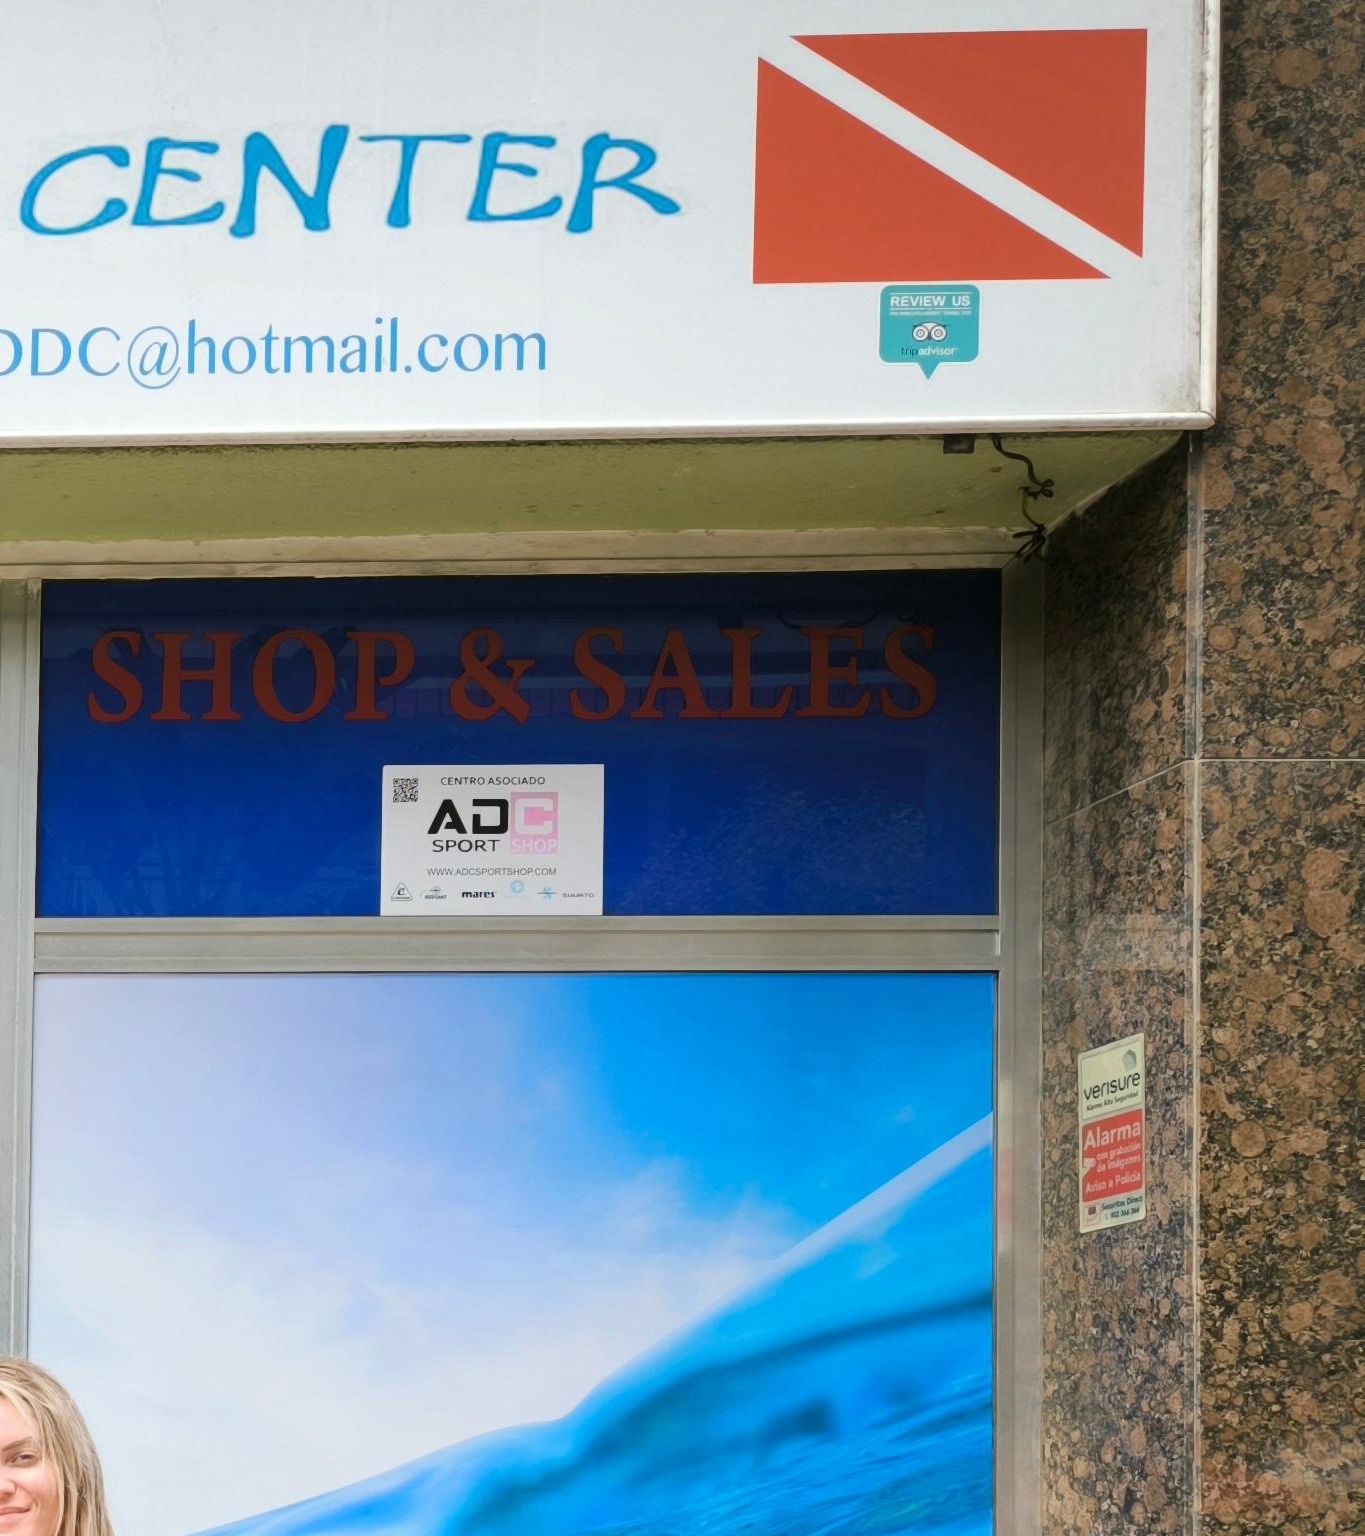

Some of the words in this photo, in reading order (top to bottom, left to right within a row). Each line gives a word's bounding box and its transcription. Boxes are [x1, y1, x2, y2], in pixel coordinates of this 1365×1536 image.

[18, 124, 682, 240] CENTER
[890, 295, 946, 307] REVIEW
[952, 295, 971, 307] US
[901, 345, 956, 357] tripadvisor
[87, 626, 416, 724] SHOP
[448, 626, 540, 724] &
[568, 626, 940, 722] SALES
[440, 776, 486, 786] CENTRO
[487, 776, 546, 786] ASOCIADO
[427, 797, 554, 835] ADC
[431, 839, 501, 853] SPORT
[511, 838, 558, 852] SHOP
[427, 867, 557, 877] WWW.ADCSPORTSHOP.COM
[461, 890, 496, 899] mares
[1083, 1072, 1141, 1101] verisure
[1083, 1121, 1141, 1151] Alarma
[1096, 1161, 1107, 1173] de
[1085, 1180, 1107, 1194] Aviso
